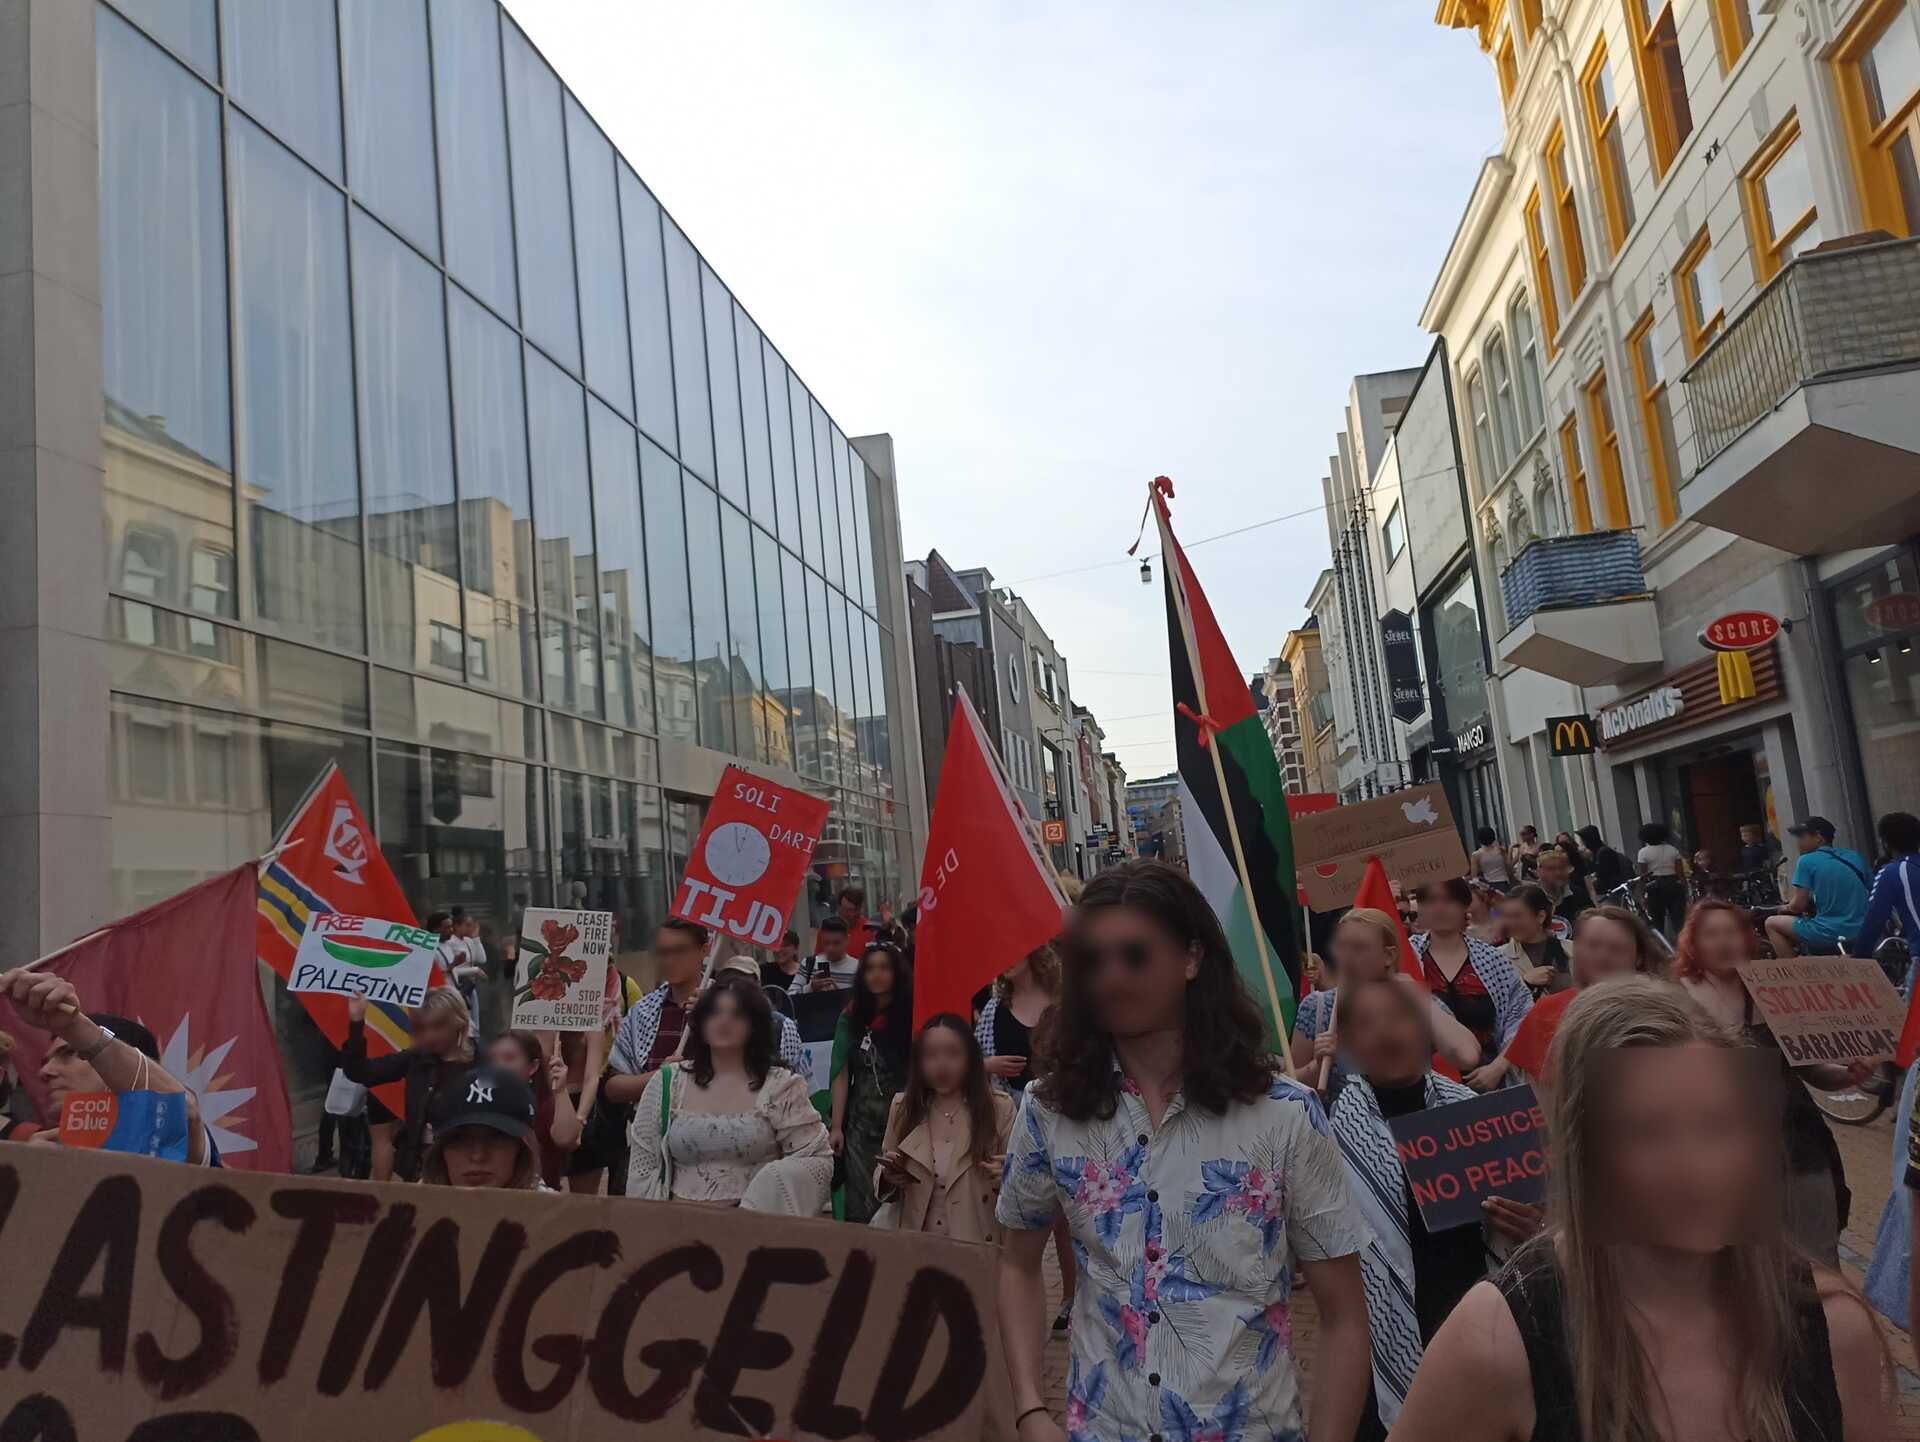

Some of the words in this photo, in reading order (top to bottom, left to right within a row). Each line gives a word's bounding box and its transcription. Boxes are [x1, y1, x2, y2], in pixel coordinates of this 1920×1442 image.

[1714, 619, 1772, 641] SCORE
[1457, 725, 1484, 754] MANGO
[734, 783, 782, 813] SOLI
[769, 824, 816, 854] DARI
[576, 912, 610, 927] CEASE
[681, 877, 783, 945] TIJD
[312, 912, 364, 931] FREE
[385, 924, 441, 950] FREE
[584, 927, 608, 941] FIRE
[582, 942, 606, 955] NOW
[579, 990, 601, 1001] STOP
[1756, 982, 1882, 1015] SOCIALISME
[515, 1014, 538, 1025] FREE
[554, 1003, 600, 1016] GENOCIDE
[70, 1097, 111, 1113] cool
[66, 1114, 108, 1130] blue
[1396, 1135, 1438, 1164] NO
[1444, 1107, 1547, 1151] JUSTICE
[1412, 1173, 1461, 1206] NO
